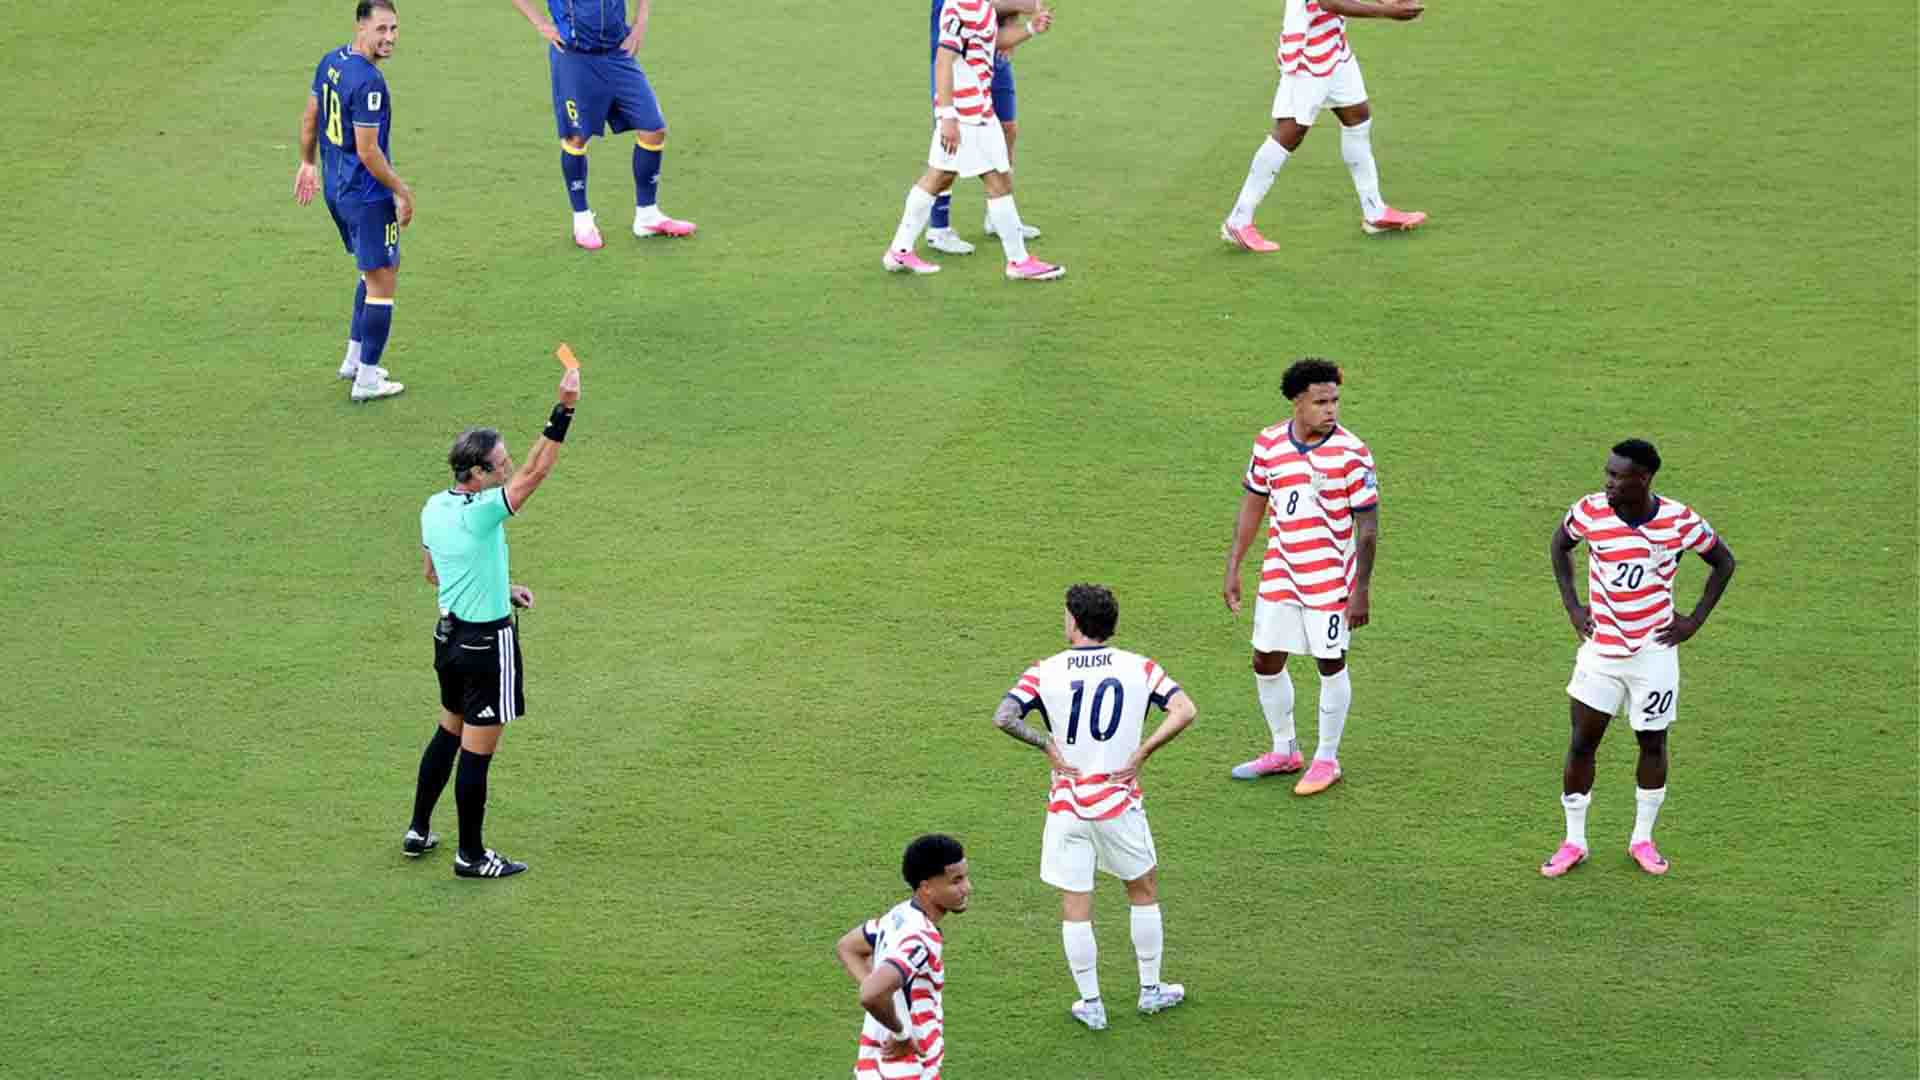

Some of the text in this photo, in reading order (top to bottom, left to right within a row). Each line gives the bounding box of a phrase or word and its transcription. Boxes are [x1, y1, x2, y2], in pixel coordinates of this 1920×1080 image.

[322, 83, 343, 147] 18
[566, 100, 578, 121] 6
[384, 222, 398, 246] 18
[1287, 491, 1299, 515] 8
[1612, 563, 1644, 589] 20
[1328, 614, 1340, 640] 8
[1067, 653, 1113, 670] PULISIC
[1066, 677, 1124, 744] 10
[1643, 690, 1673, 715] 20
